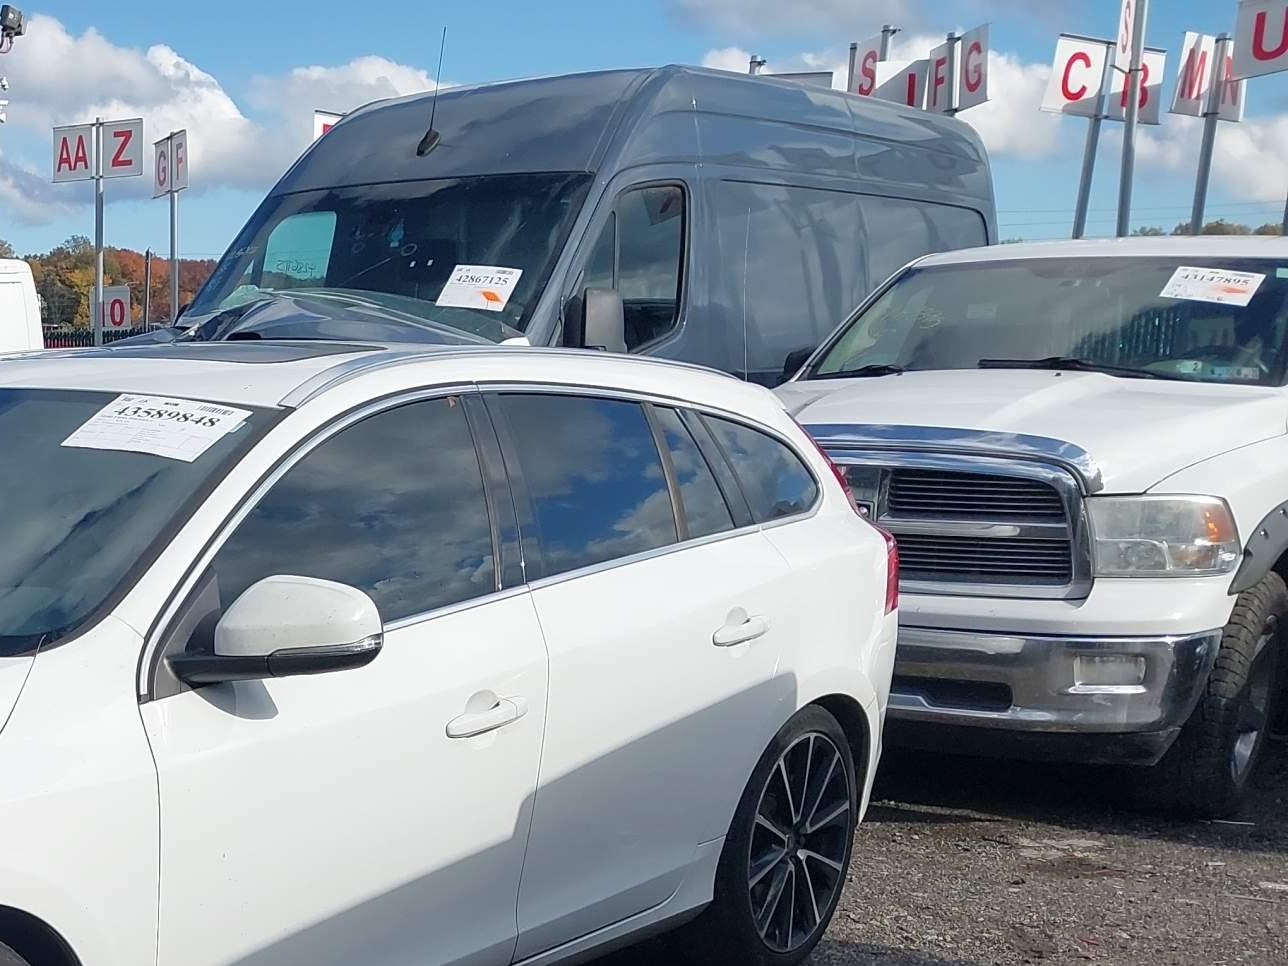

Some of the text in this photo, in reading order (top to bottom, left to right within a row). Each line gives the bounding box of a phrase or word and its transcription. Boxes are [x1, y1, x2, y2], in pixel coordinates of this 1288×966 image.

[1252, 6, 1288, 61] U
[859, 50, 877, 96] S
[933, 56, 947, 107] F
[965, 41, 982, 93] G
[1061, 51, 1092, 101] C
[1180, 47, 1208, 101] M
[57, 134, 88, 172] AA
[112, 130, 132, 167] Z
[157, 151, 167, 186] G
[175, 142, 184, 180] F
[113, 405, 221, 428] 43589848
